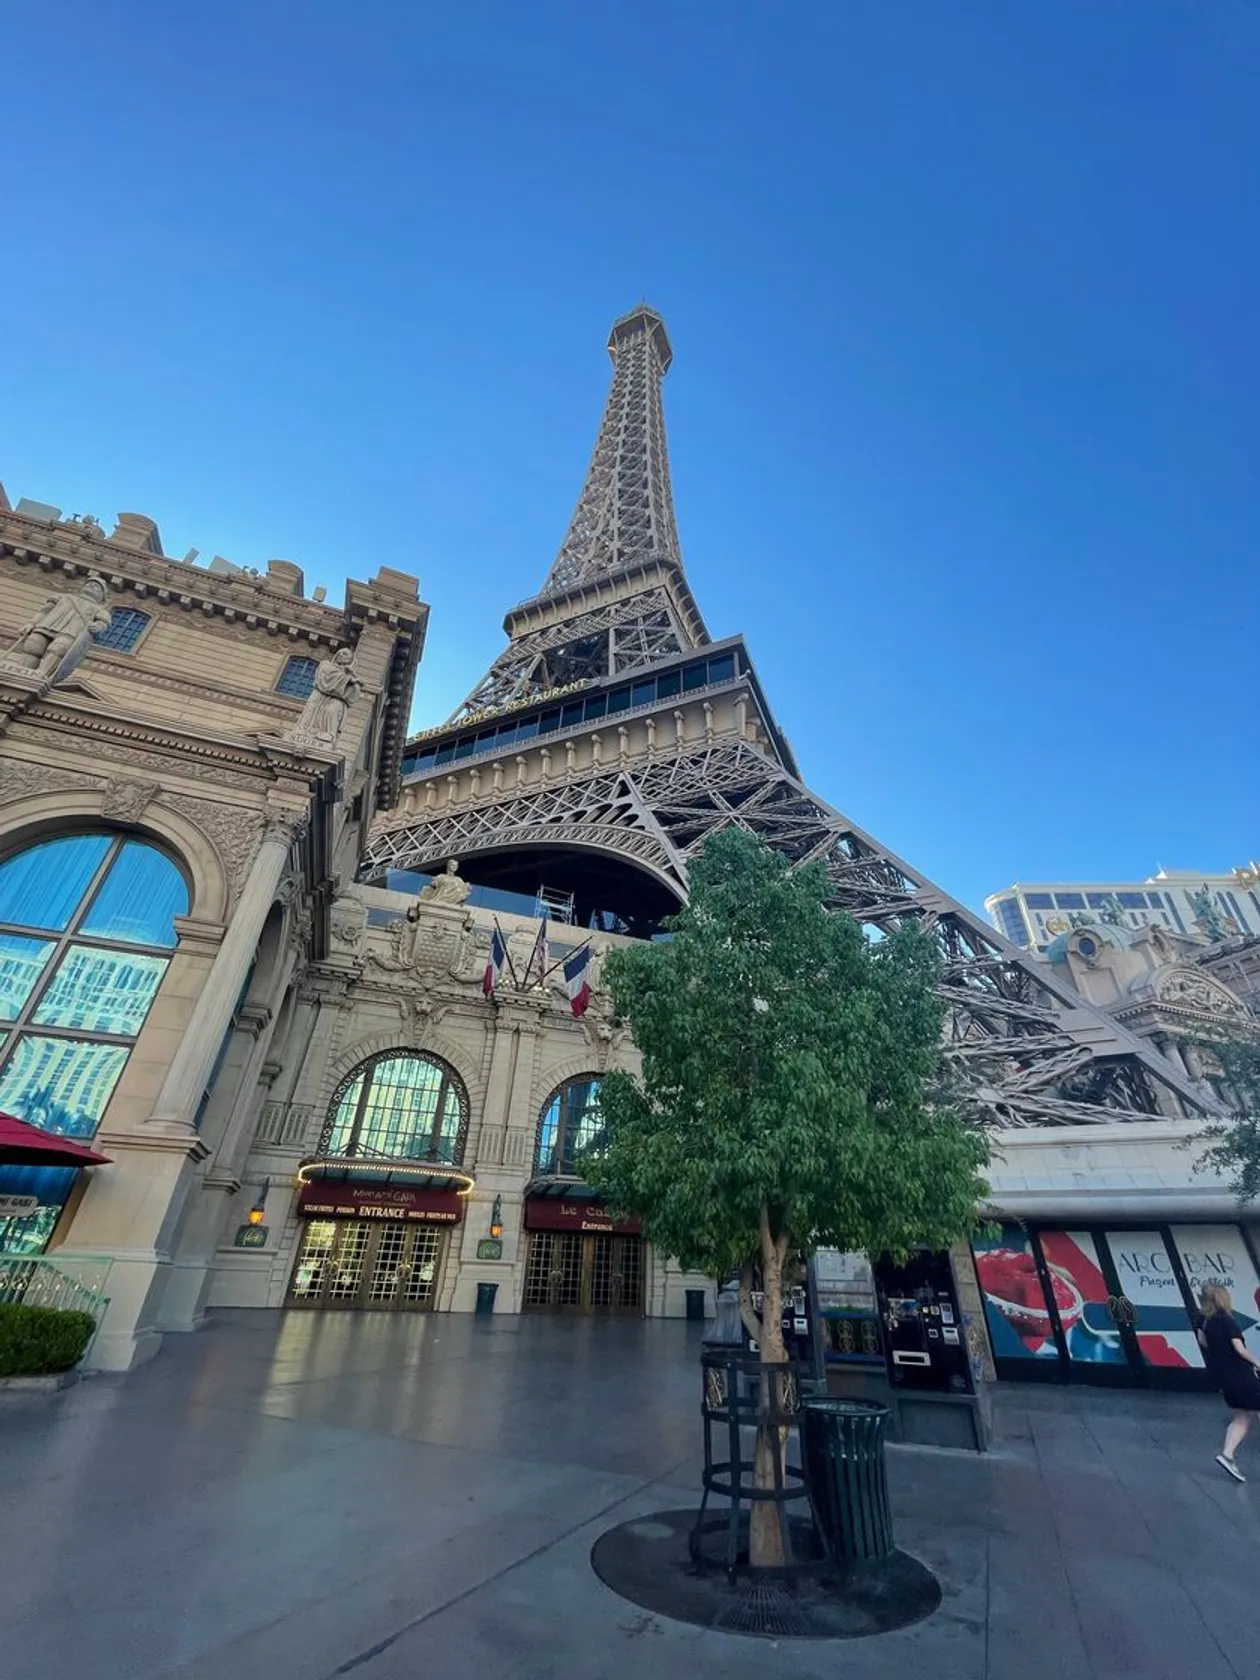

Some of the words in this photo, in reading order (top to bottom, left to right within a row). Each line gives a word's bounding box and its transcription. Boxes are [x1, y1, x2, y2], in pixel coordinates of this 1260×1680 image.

[504, 678, 588, 713] RESTAURANT
[358, 1205, 405, 1219] ENTRANCE
[582, 1220, 613, 1231] Entrance
[1119, 1252, 1170, 1273] ARC
[1183, 1252, 1235, 1274] BAR
